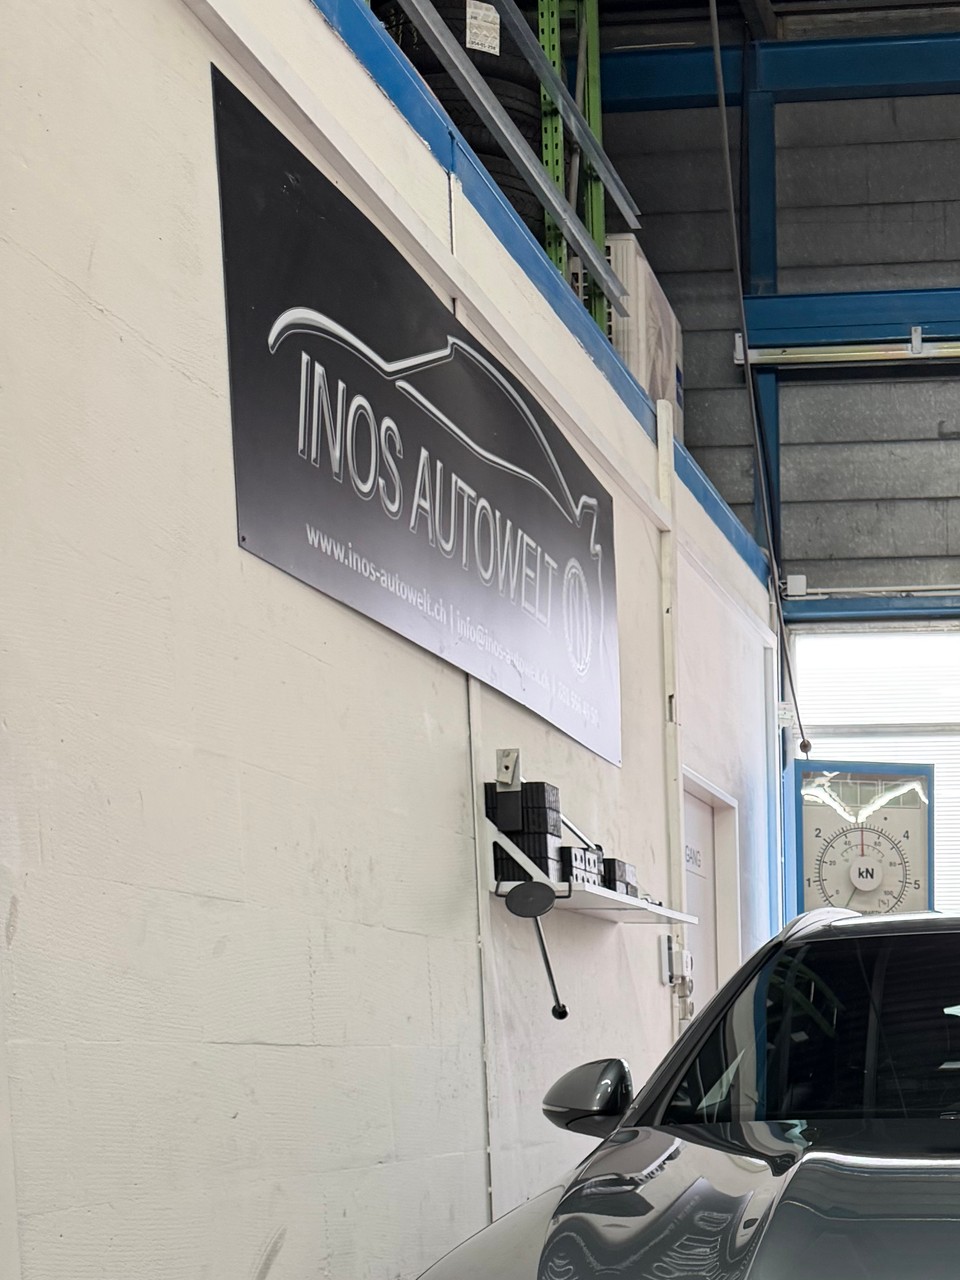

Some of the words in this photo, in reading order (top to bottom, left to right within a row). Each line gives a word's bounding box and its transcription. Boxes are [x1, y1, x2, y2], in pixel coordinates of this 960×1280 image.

[298, 350, 403, 520] INOS
[409, 446, 559, 630] AUTOWELT
[306, 523, 446, 625] www.inos-autowelt.ch
[814, 828, 822, 838] 2
[903, 831, 910, 840] 4
[858, 867, 874, 879] kN
[806, 878, 812, 888] 1
[913, 880, 921, 889] 5
